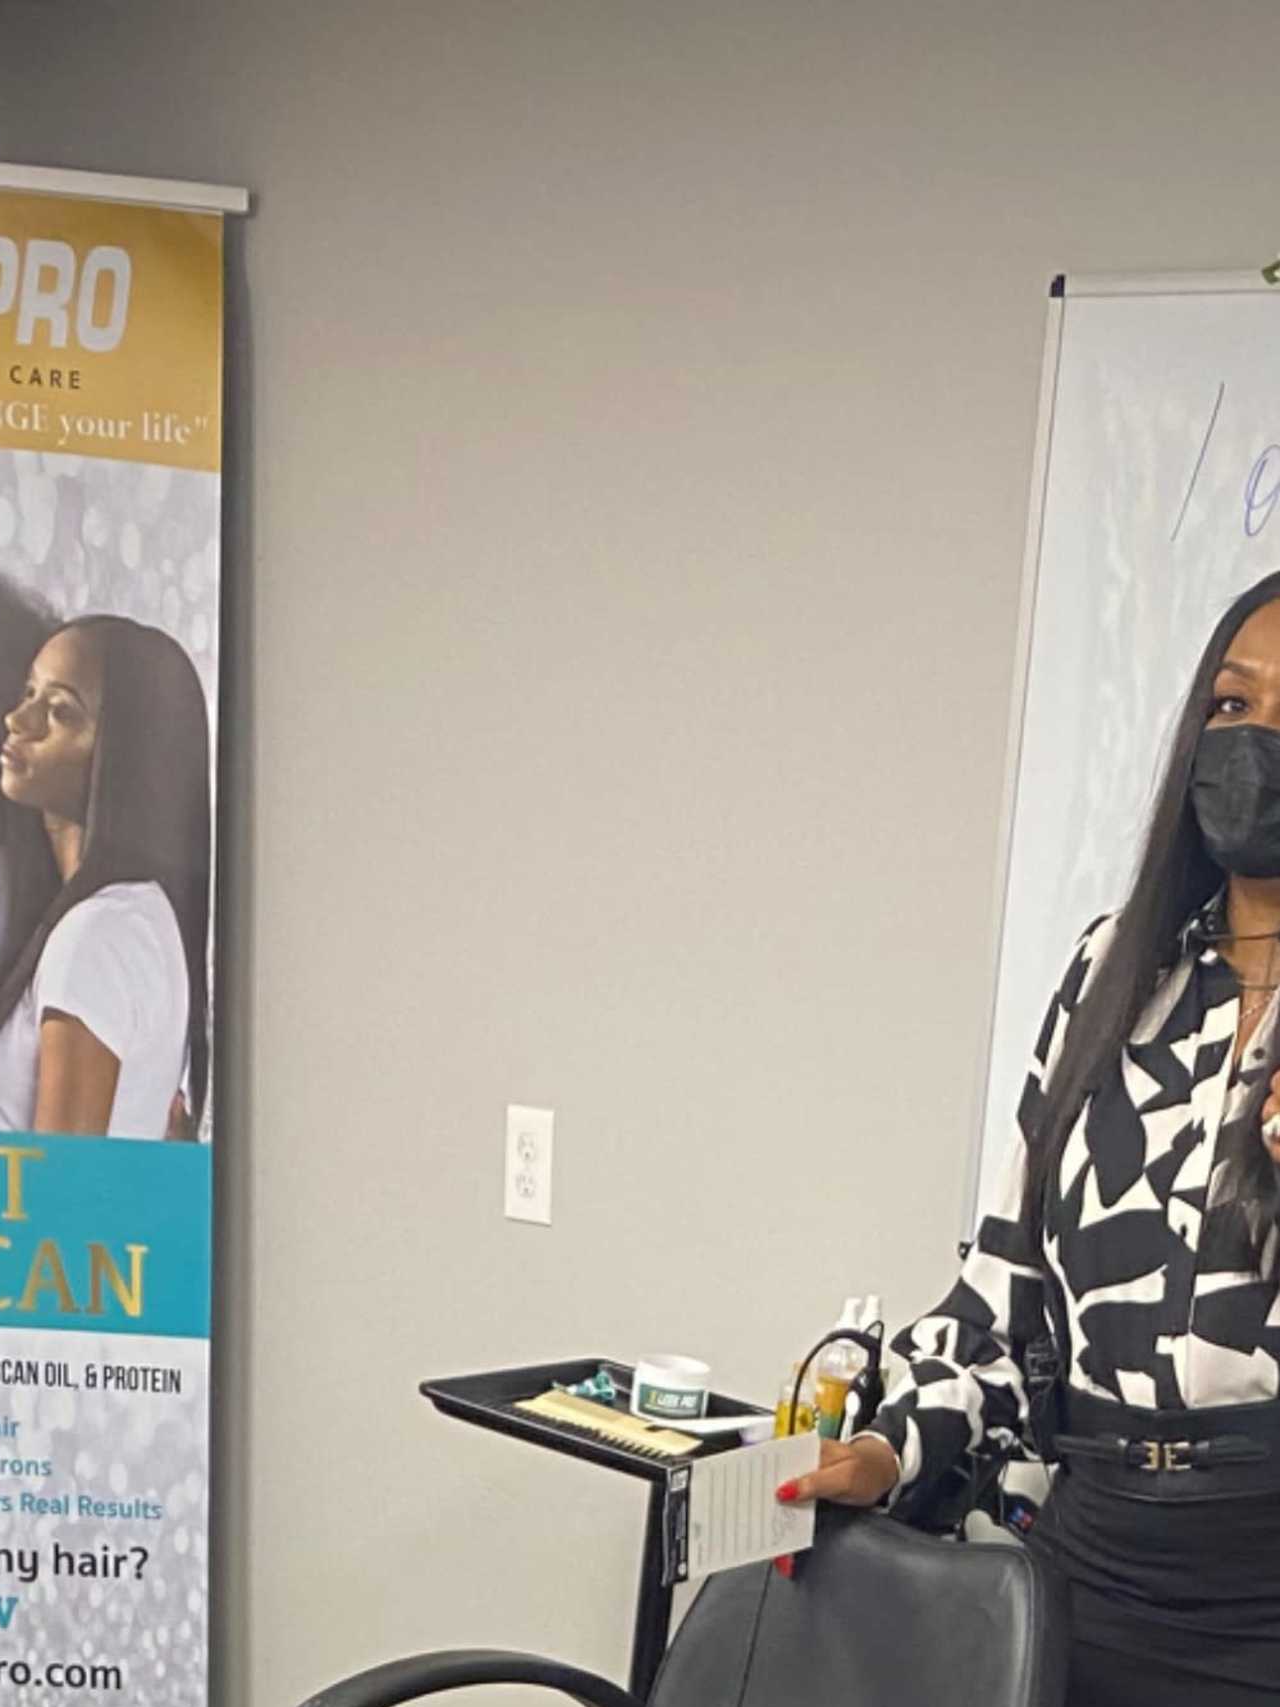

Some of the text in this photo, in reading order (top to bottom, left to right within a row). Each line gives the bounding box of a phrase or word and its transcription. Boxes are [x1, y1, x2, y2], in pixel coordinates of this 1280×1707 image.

[9, 365, 81, 389] CARE
[58, 411, 133, 446] your
[44, 1361, 80, 1391] OIL,
[85, 1363, 97, 1389] &
[102, 1365, 182, 1393] PROTEIN
[20, 1492, 70, 1516] Real
[77, 1494, 164, 1520] Results
[52, 1542, 149, 1581] hair?
